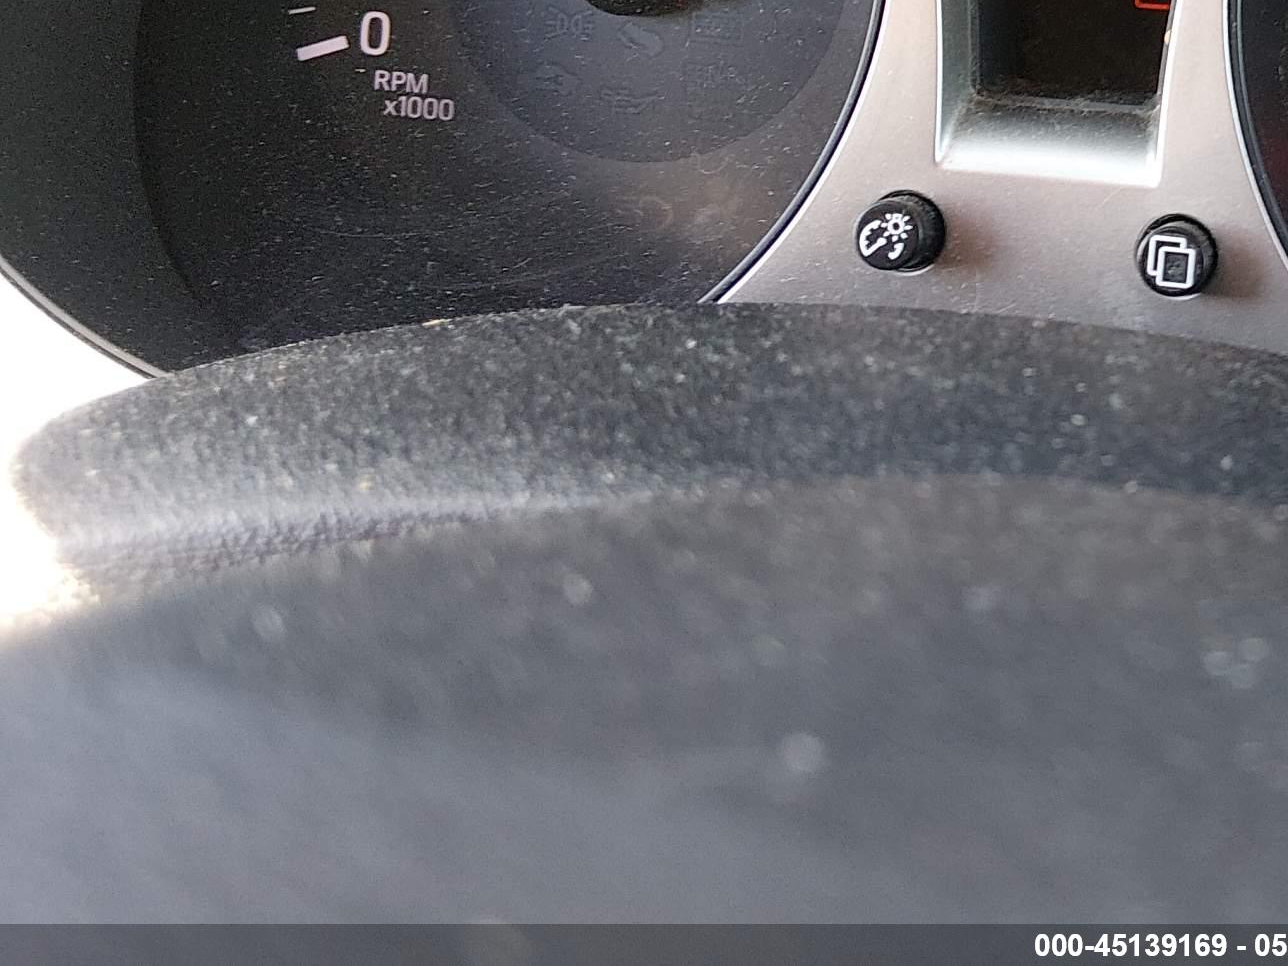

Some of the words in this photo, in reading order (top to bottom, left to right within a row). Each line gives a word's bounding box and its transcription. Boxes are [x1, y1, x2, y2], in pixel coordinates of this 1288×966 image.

[359, 11, 391, 56] 0
[374, 69, 429, 94] RPM
[383, 96, 455, 121] x1000
